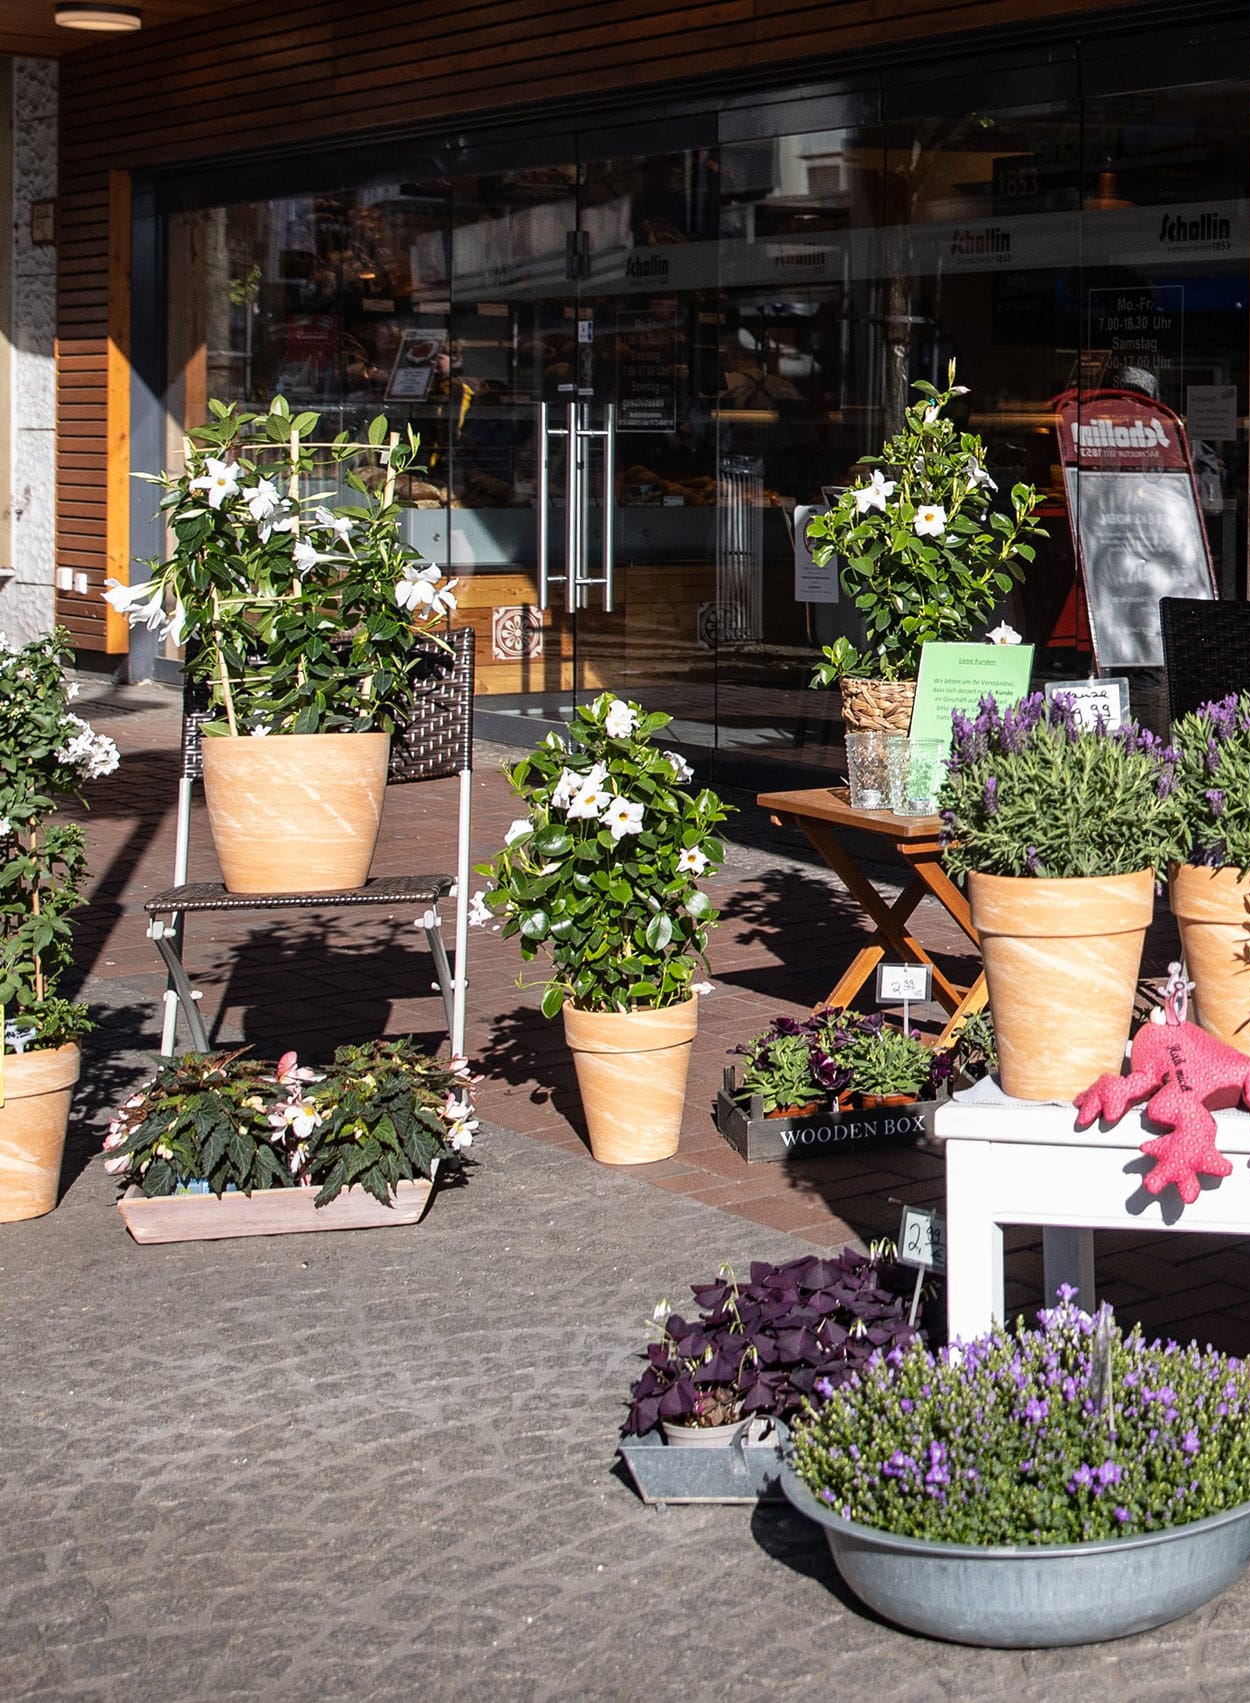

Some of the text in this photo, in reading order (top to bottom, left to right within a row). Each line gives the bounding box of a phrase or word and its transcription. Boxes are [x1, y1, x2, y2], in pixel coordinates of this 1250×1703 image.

[1153, 316, 1173, 330] Uhr
[1112, 337, 1158, 352] Samstag
[780, 1115, 926, 1148] WOODEN BOX
